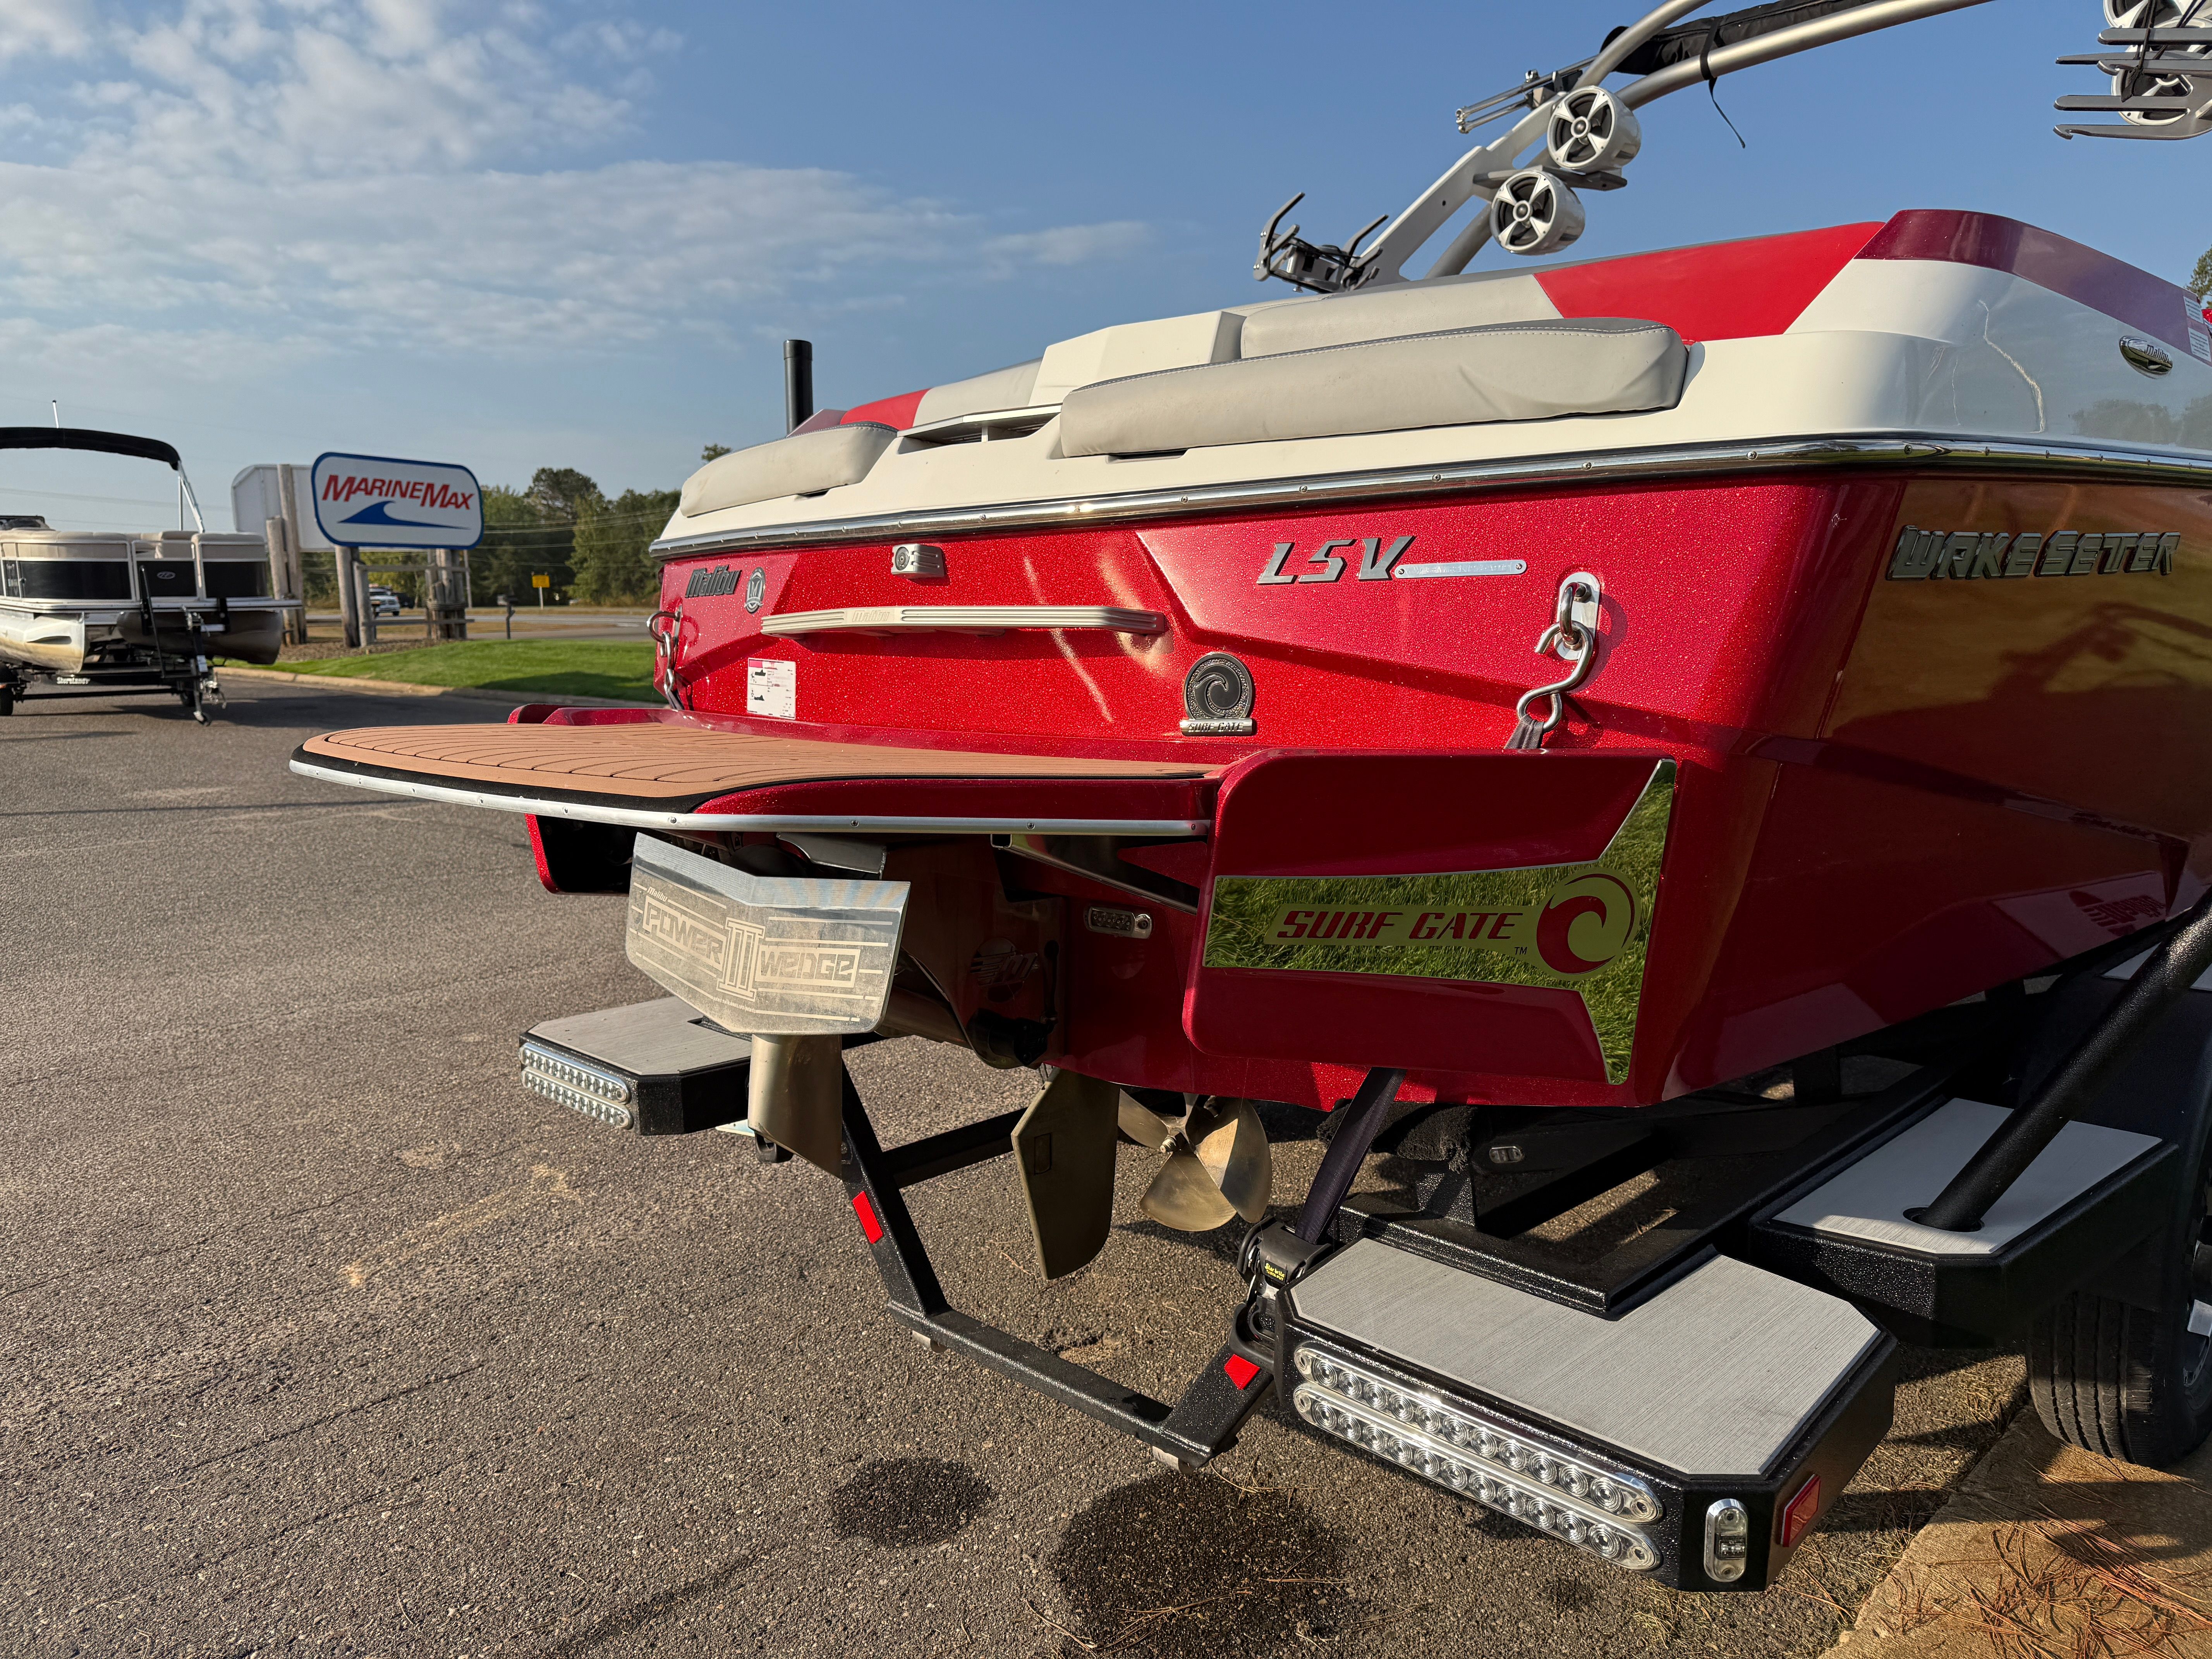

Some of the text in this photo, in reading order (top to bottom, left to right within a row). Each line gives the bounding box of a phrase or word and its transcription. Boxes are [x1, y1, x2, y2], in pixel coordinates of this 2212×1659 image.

[2147, 344, 2168, 362] Malibu
[1257, 536, 1416, 585] LSV
[1886, 524, 2181, 580] WAKESETTER
[685, 564, 742, 598] Malibu
[852, 610, 890, 622] Malibu
[1188, 722, 1244, 732] SURF GATE
[647, 886, 668, 902] Malibu
[1277, 910, 1524, 940] SURF GATE
[1514, 946, 1528, 955] TM
